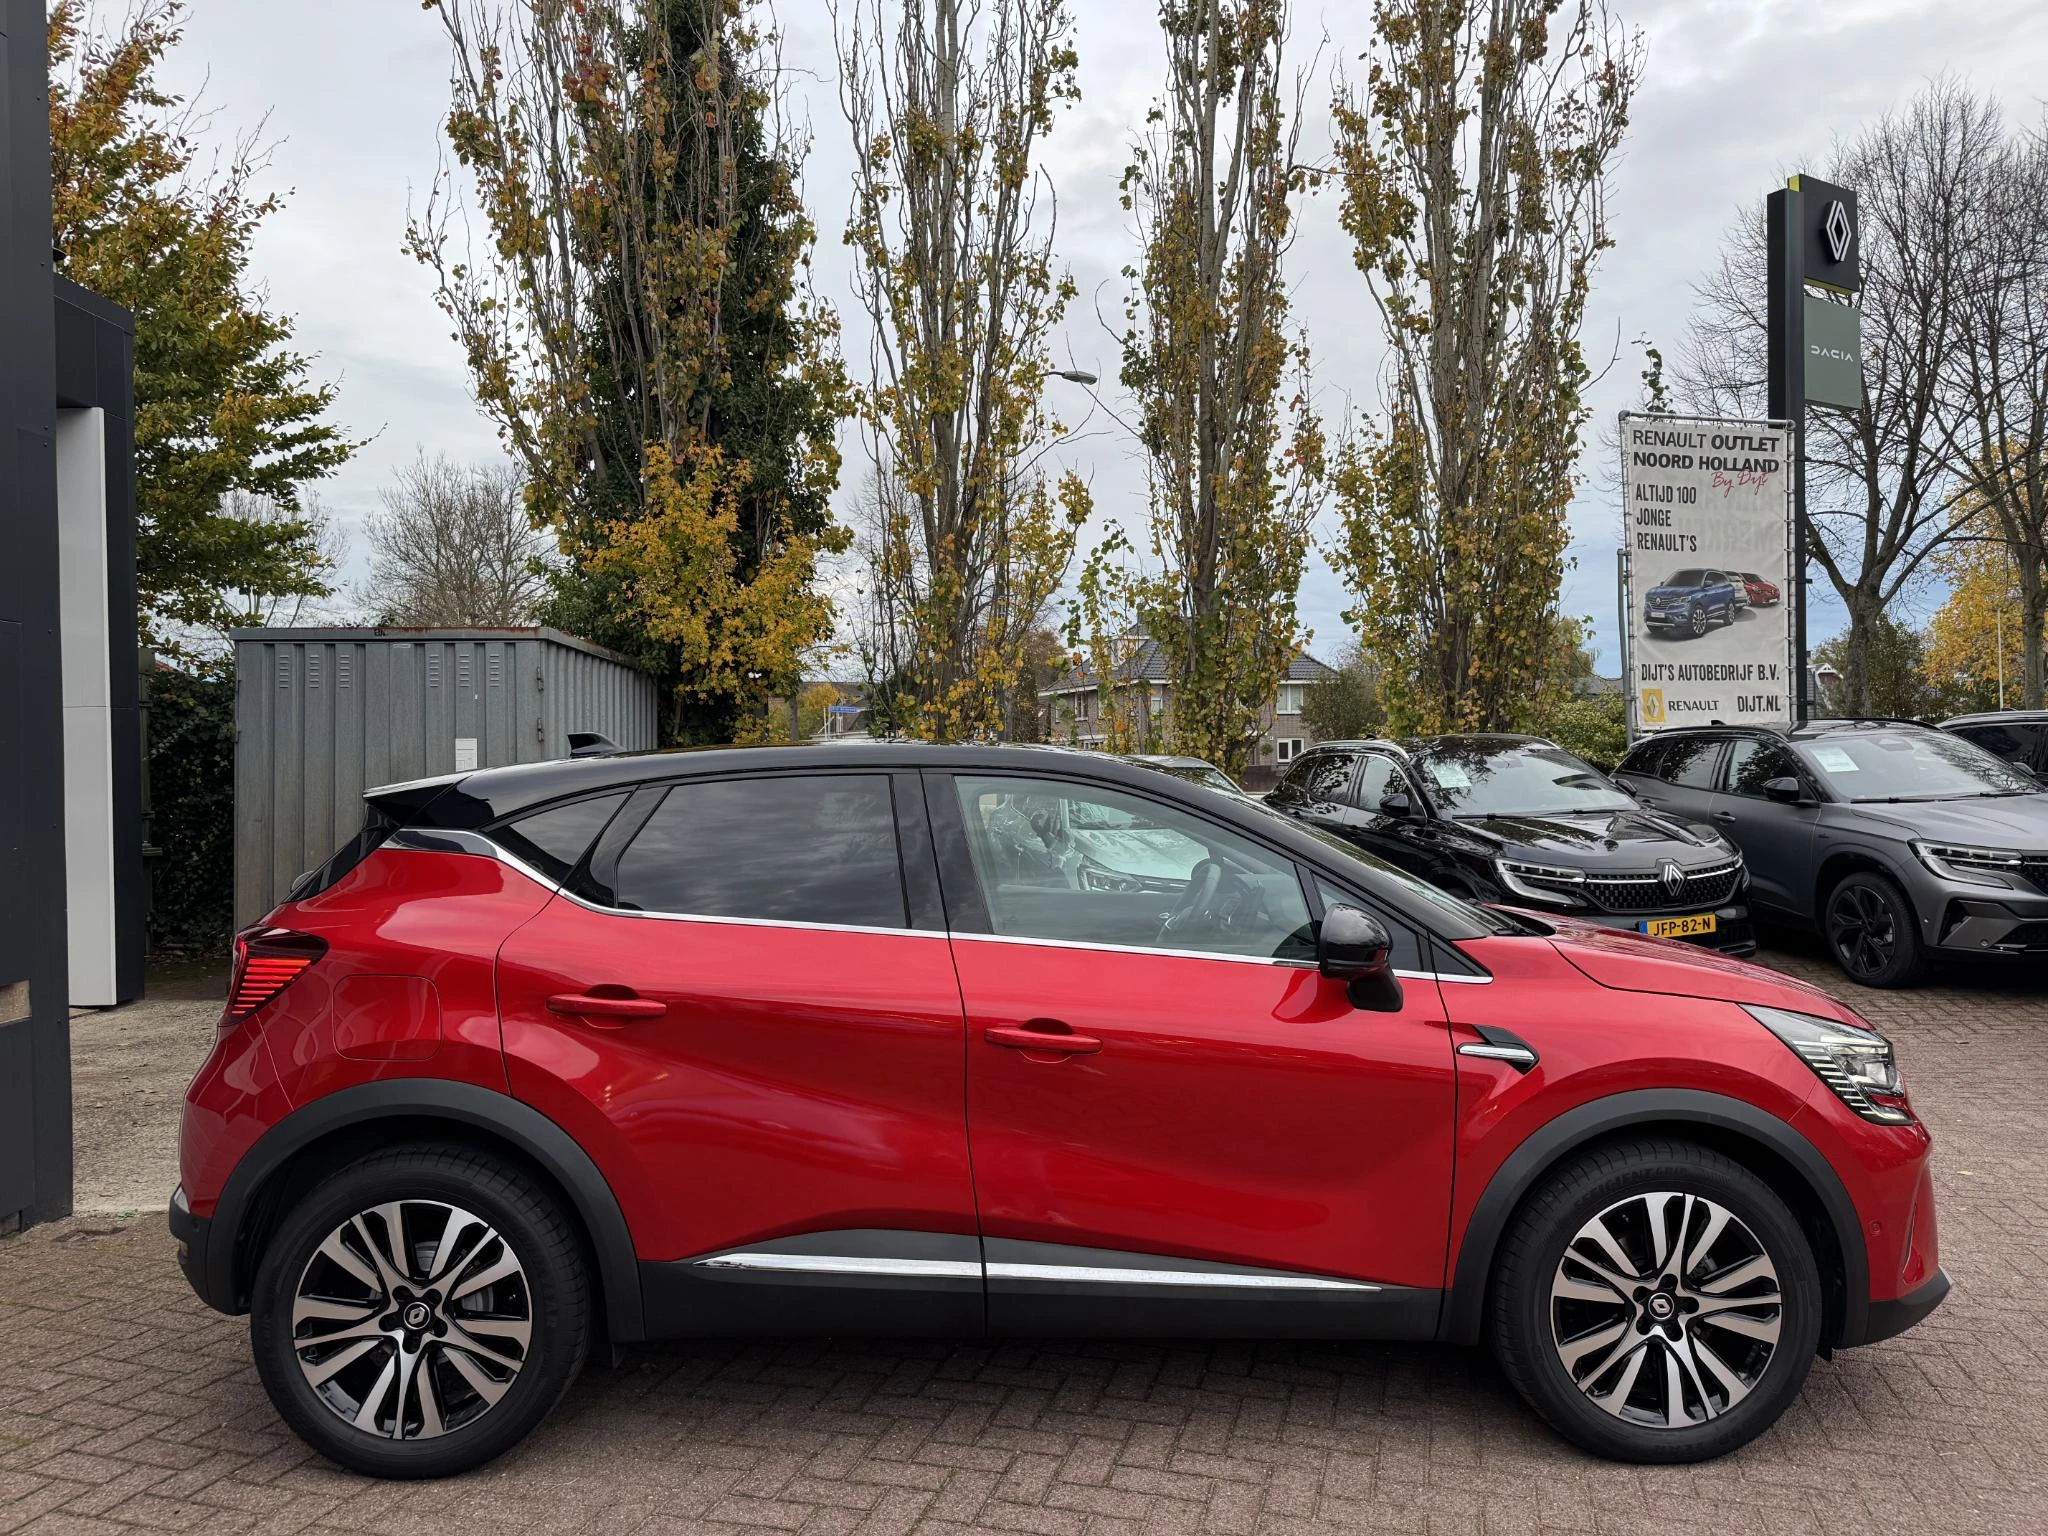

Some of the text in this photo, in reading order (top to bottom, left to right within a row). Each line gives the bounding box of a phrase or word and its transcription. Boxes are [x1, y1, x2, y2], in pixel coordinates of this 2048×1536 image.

[1811, 344, 1853, 362] DACIA
[1633, 429, 1780, 452] RENAULT OUTLET
[1633, 452, 1779, 472] NOORD HOLLAND
[1636, 483, 1697, 504] ALTIJD 100
[1711, 471, 1734, 498] By
[1637, 507, 1672, 527] JONGE
[1637, 532, 1697, 552] RENAULT'S
[1641, 664, 1780, 681] DIJT'S AUTOBEDRIJF B.V.
[1668, 700, 1720, 711] RENAULT
[1737, 695, 1781, 712] DIJT.NL
[1653, 917, 1711, 937] JFP-82-N
